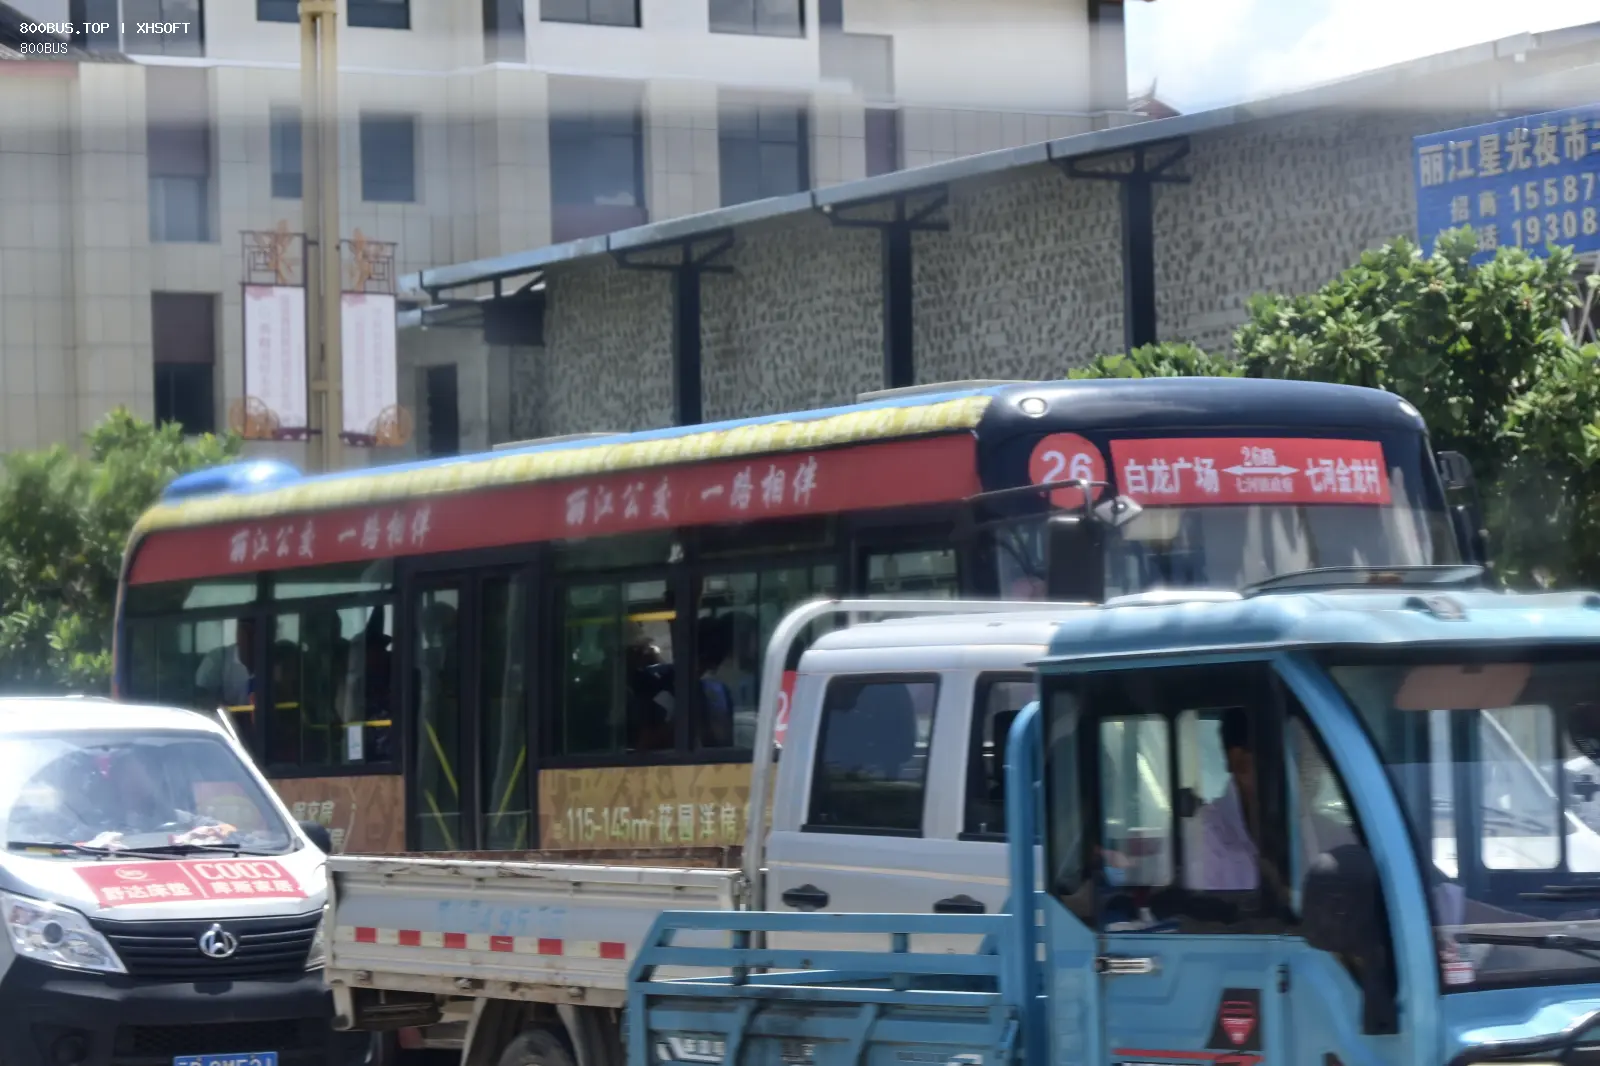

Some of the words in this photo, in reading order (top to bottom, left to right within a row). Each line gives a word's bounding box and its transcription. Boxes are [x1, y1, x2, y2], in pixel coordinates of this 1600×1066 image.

[1419, 117, 1600, 187] 丽江星光夜市
[1042, 450, 1093, 485] 26
[1123, 456, 1219, 495] 白龙广场
[566, 475, 670, 526] 丽江公交
[701, 456, 818, 511] 一路相伴
[229, 519, 315, 564] 丽江公交
[566, 802, 748, 842] 115-145m²花园洋房
